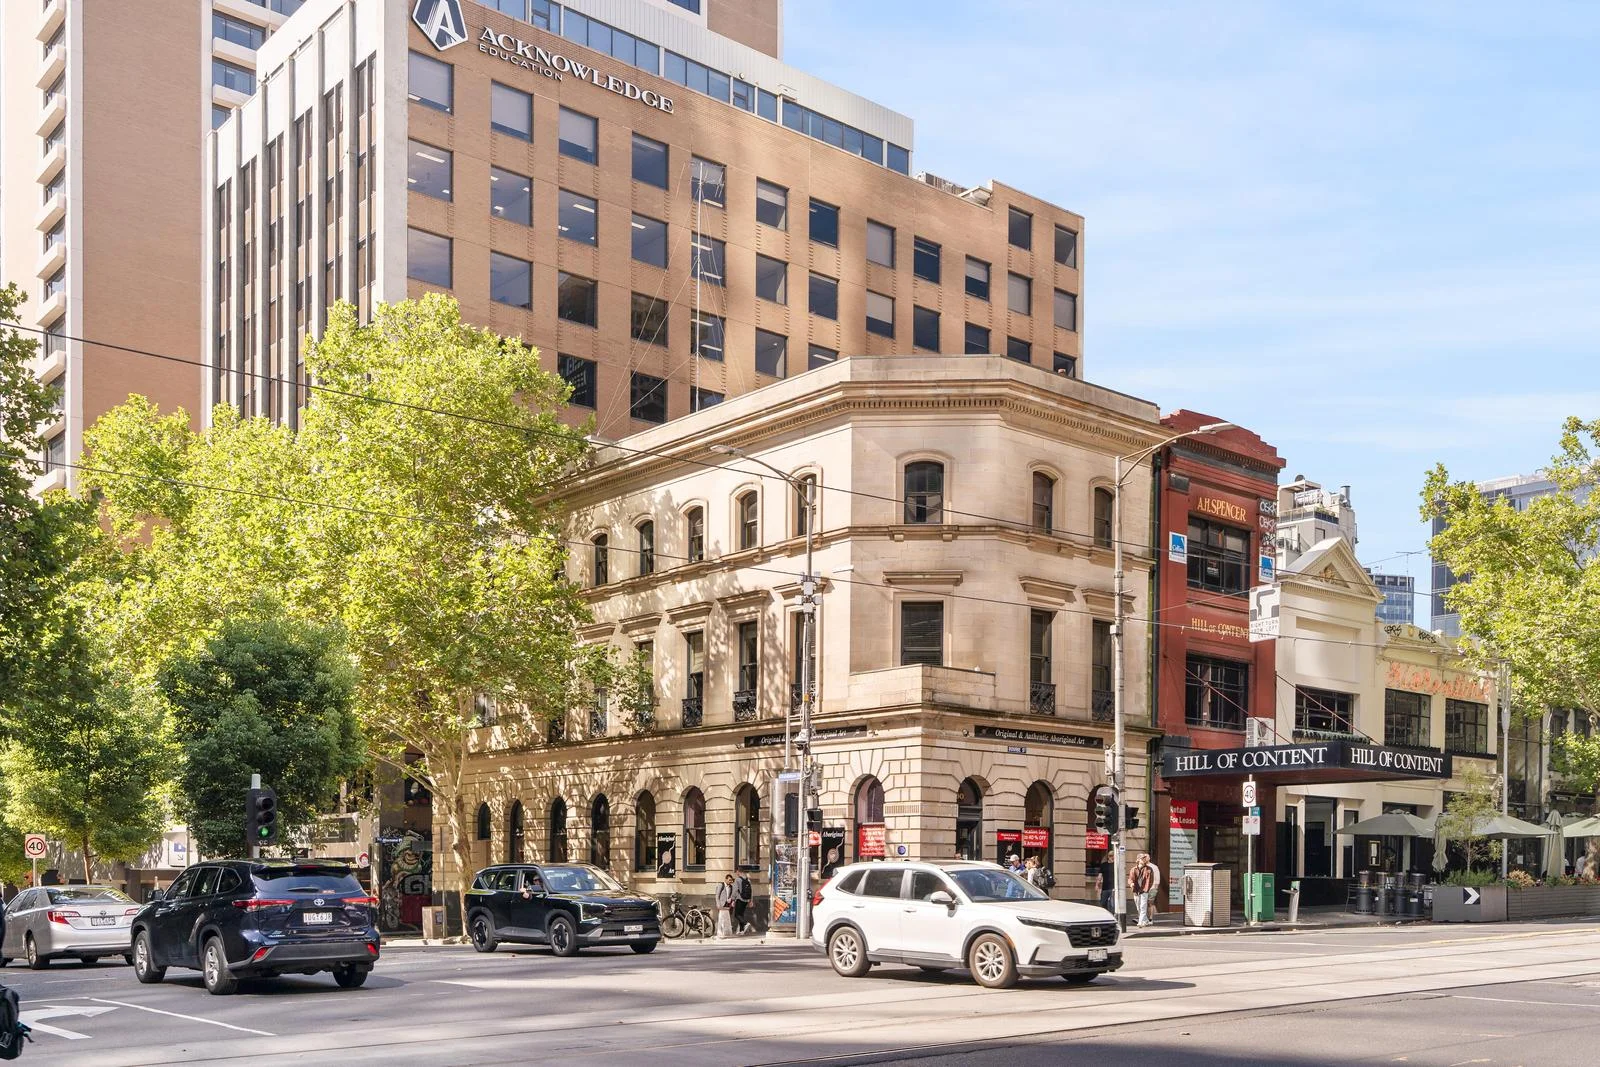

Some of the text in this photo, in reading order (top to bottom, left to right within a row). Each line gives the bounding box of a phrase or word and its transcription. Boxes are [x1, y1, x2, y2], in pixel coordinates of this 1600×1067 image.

[479, 43, 563, 82] EDUCATION
[479, 26, 674, 114] ACKNOWLEDGE
[1191, 618, 1208, 631] HILL
[995, 728, 1018, 739] Original
[1024, 732, 1049, 742] Authentic
[1050, 733, 1076, 745] Aboriginal
[1176, 747, 1327, 771] HILL OF CONTENT
[1351, 748, 1443, 773] HILL OF CONTENT
[1245, 789, 1254, 798] 40
[1170, 806, 1187, 814] Retail
[1170, 815, 1196, 824] For Lease
[823, 831, 844, 839] Aboriginal
[29, 841, 43, 852] 40
